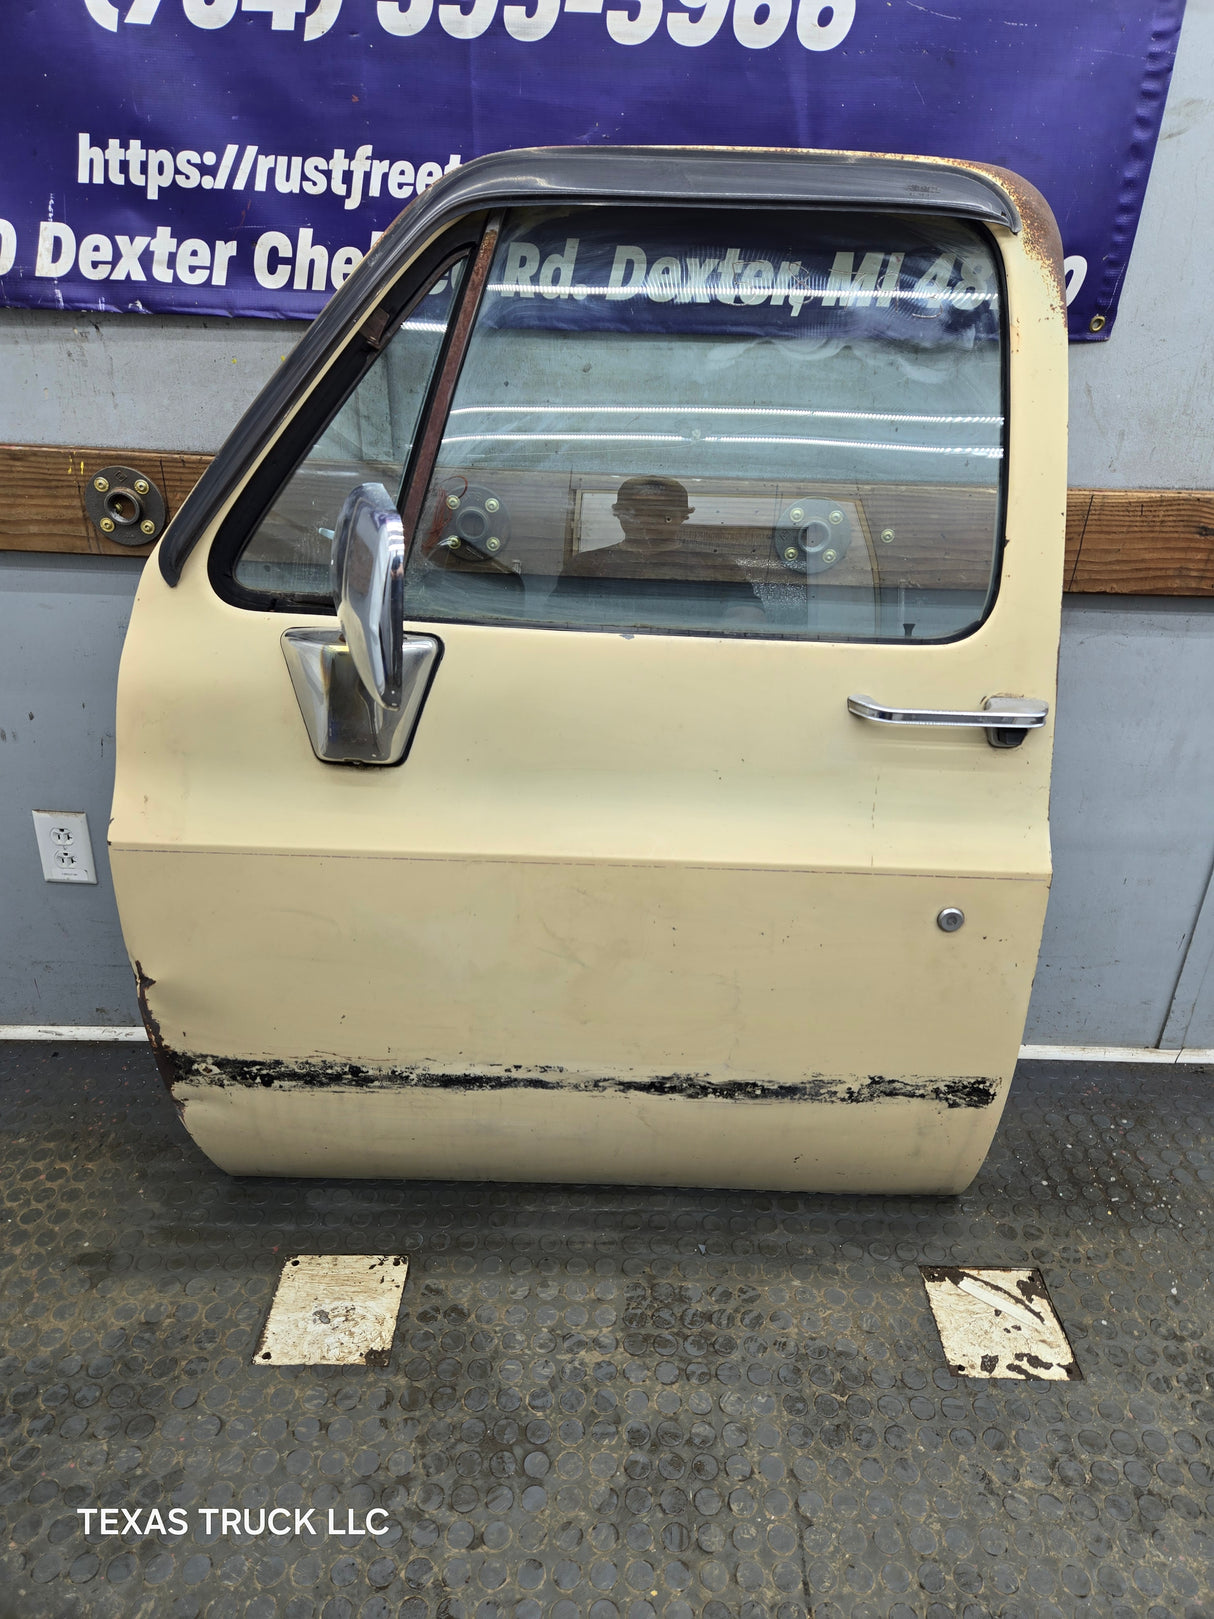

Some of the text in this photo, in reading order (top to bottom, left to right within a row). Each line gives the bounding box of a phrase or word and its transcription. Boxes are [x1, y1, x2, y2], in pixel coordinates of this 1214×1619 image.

[35, 220, 238, 287] Dexter
[500, 238, 588, 301] Rd.
[605, 246, 803, 317] Dexter,
[821, 251, 906, 307] MI
